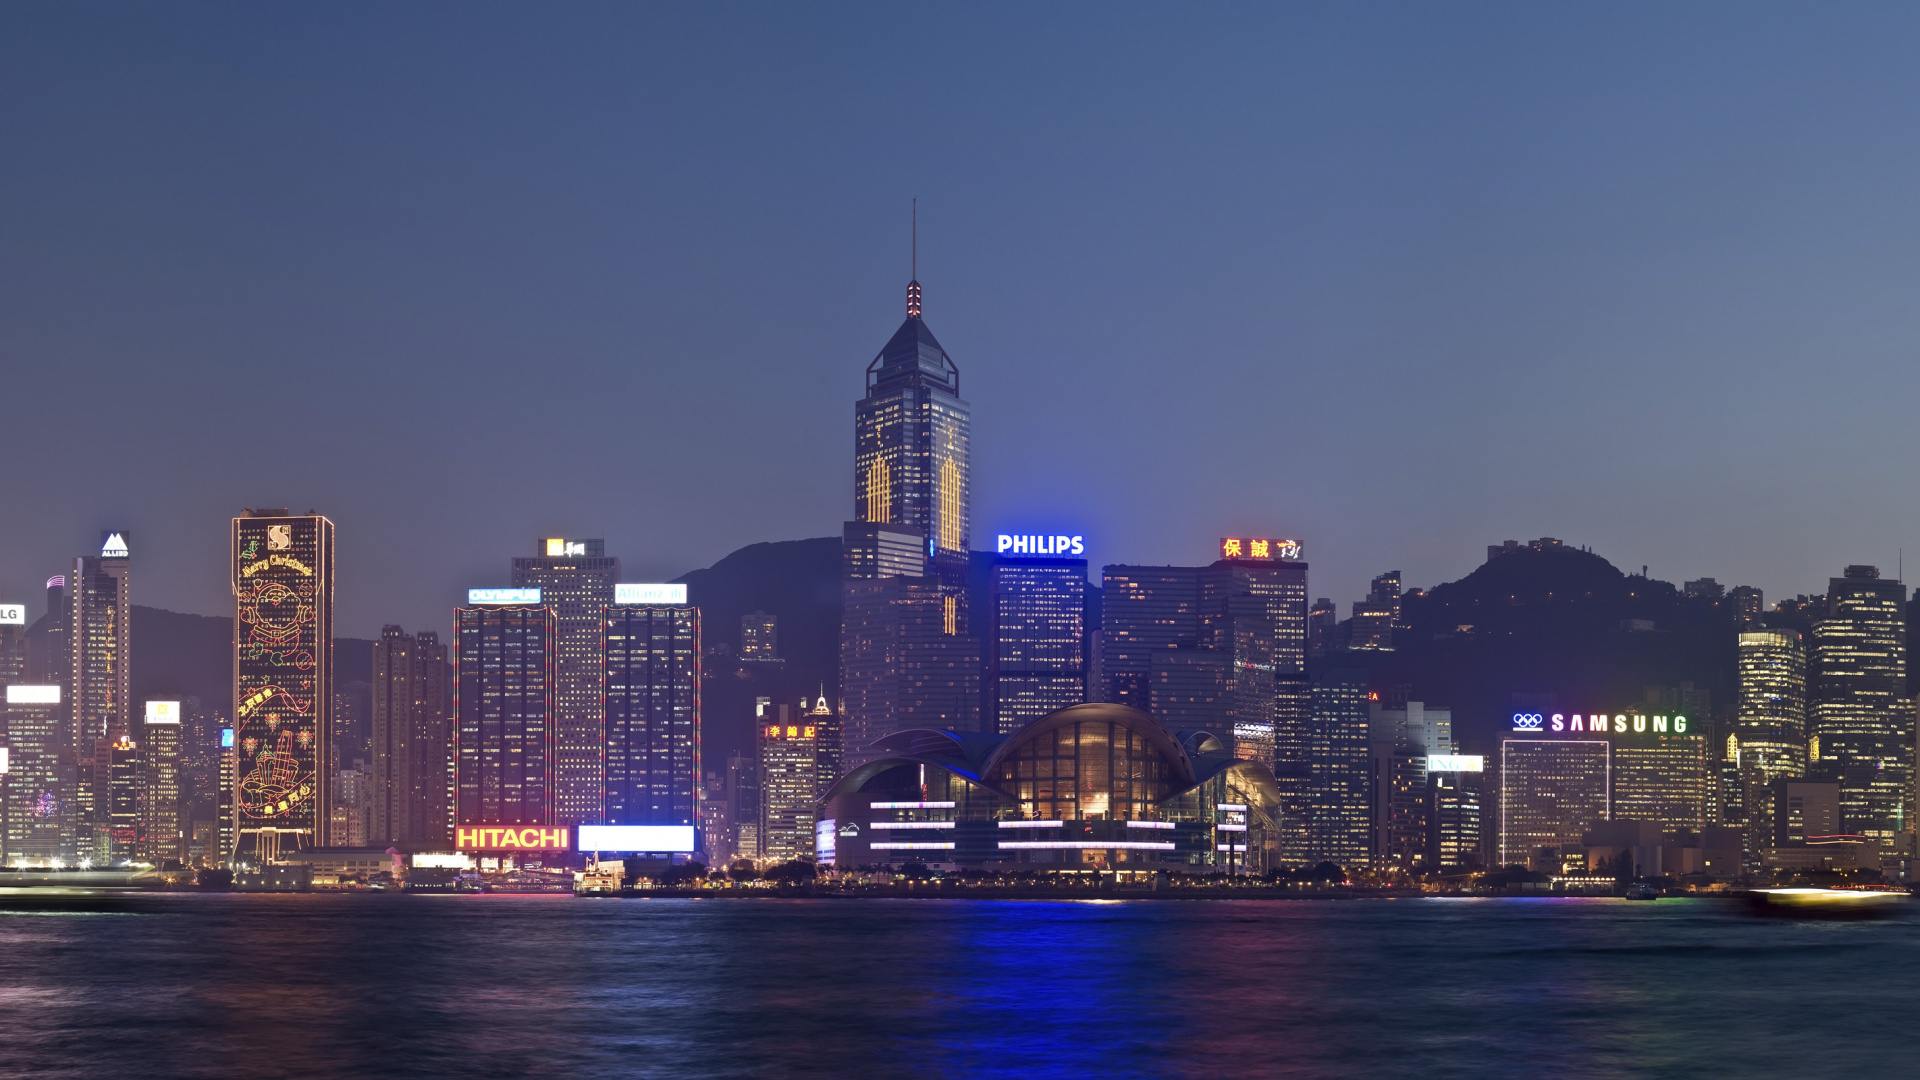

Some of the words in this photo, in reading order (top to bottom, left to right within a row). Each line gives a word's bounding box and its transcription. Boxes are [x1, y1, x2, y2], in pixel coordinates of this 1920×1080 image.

[998, 535, 1084, 555] PHILIPS
[1223, 539, 1269, 557] 保誠
[242, 559, 269, 578] Merry
[270, 554, 312, 576] Christmas
[469, 590, 540, 601] OLYMPUS
[618, 587, 664, 599] Allianz
[0, 609, 17, 619] LG
[1551, 713, 1687, 733] SAMSUNG
[1430, 759, 1459, 770] ING
[458, 828, 568, 848] HITACHI
